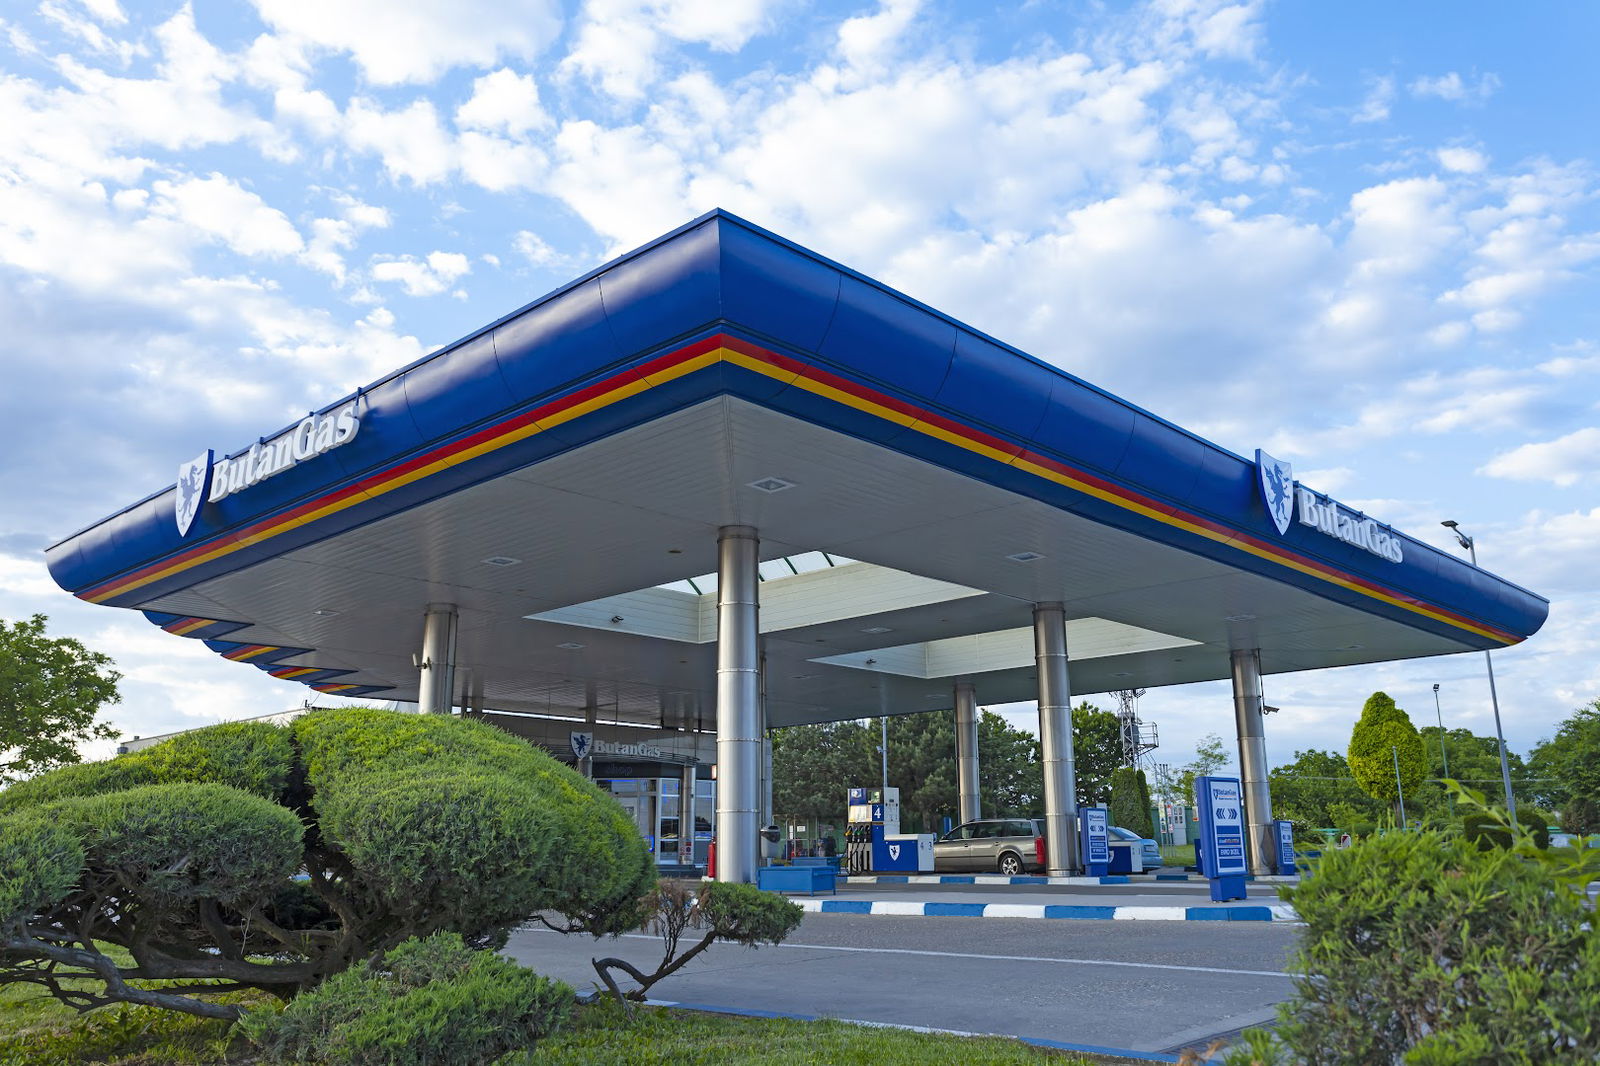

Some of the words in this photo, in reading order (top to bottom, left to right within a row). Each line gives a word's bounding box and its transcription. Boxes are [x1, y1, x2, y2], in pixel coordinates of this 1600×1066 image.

[208, 404, 360, 503] ButanGas
[1297, 487, 1403, 563] ButanGas
[594, 740, 661, 758] ButanGas
[874, 807, 882, 819] 4
